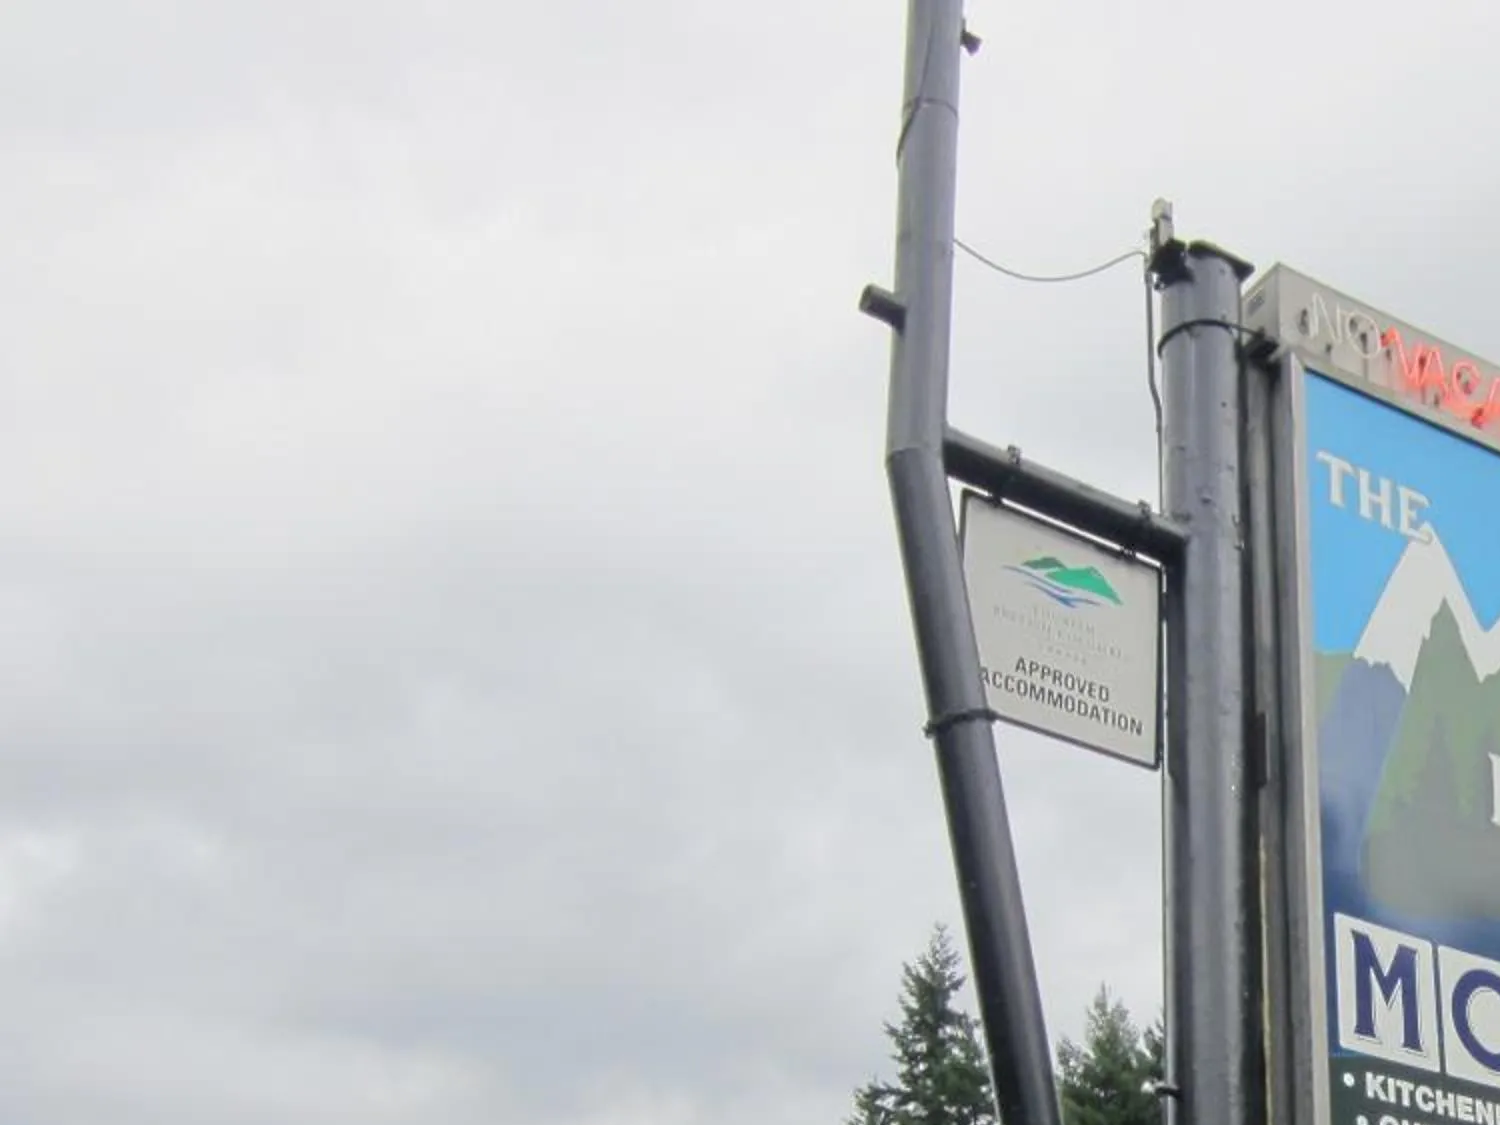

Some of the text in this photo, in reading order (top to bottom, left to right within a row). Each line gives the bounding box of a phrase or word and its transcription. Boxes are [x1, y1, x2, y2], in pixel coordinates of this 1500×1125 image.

[1308, 292, 1383, 360] NO
[1316, 450, 1432, 543] THE
[980, 666, 1143, 737] ACCOMMODATION
[1015, 656, 1110, 702] APPROVED
